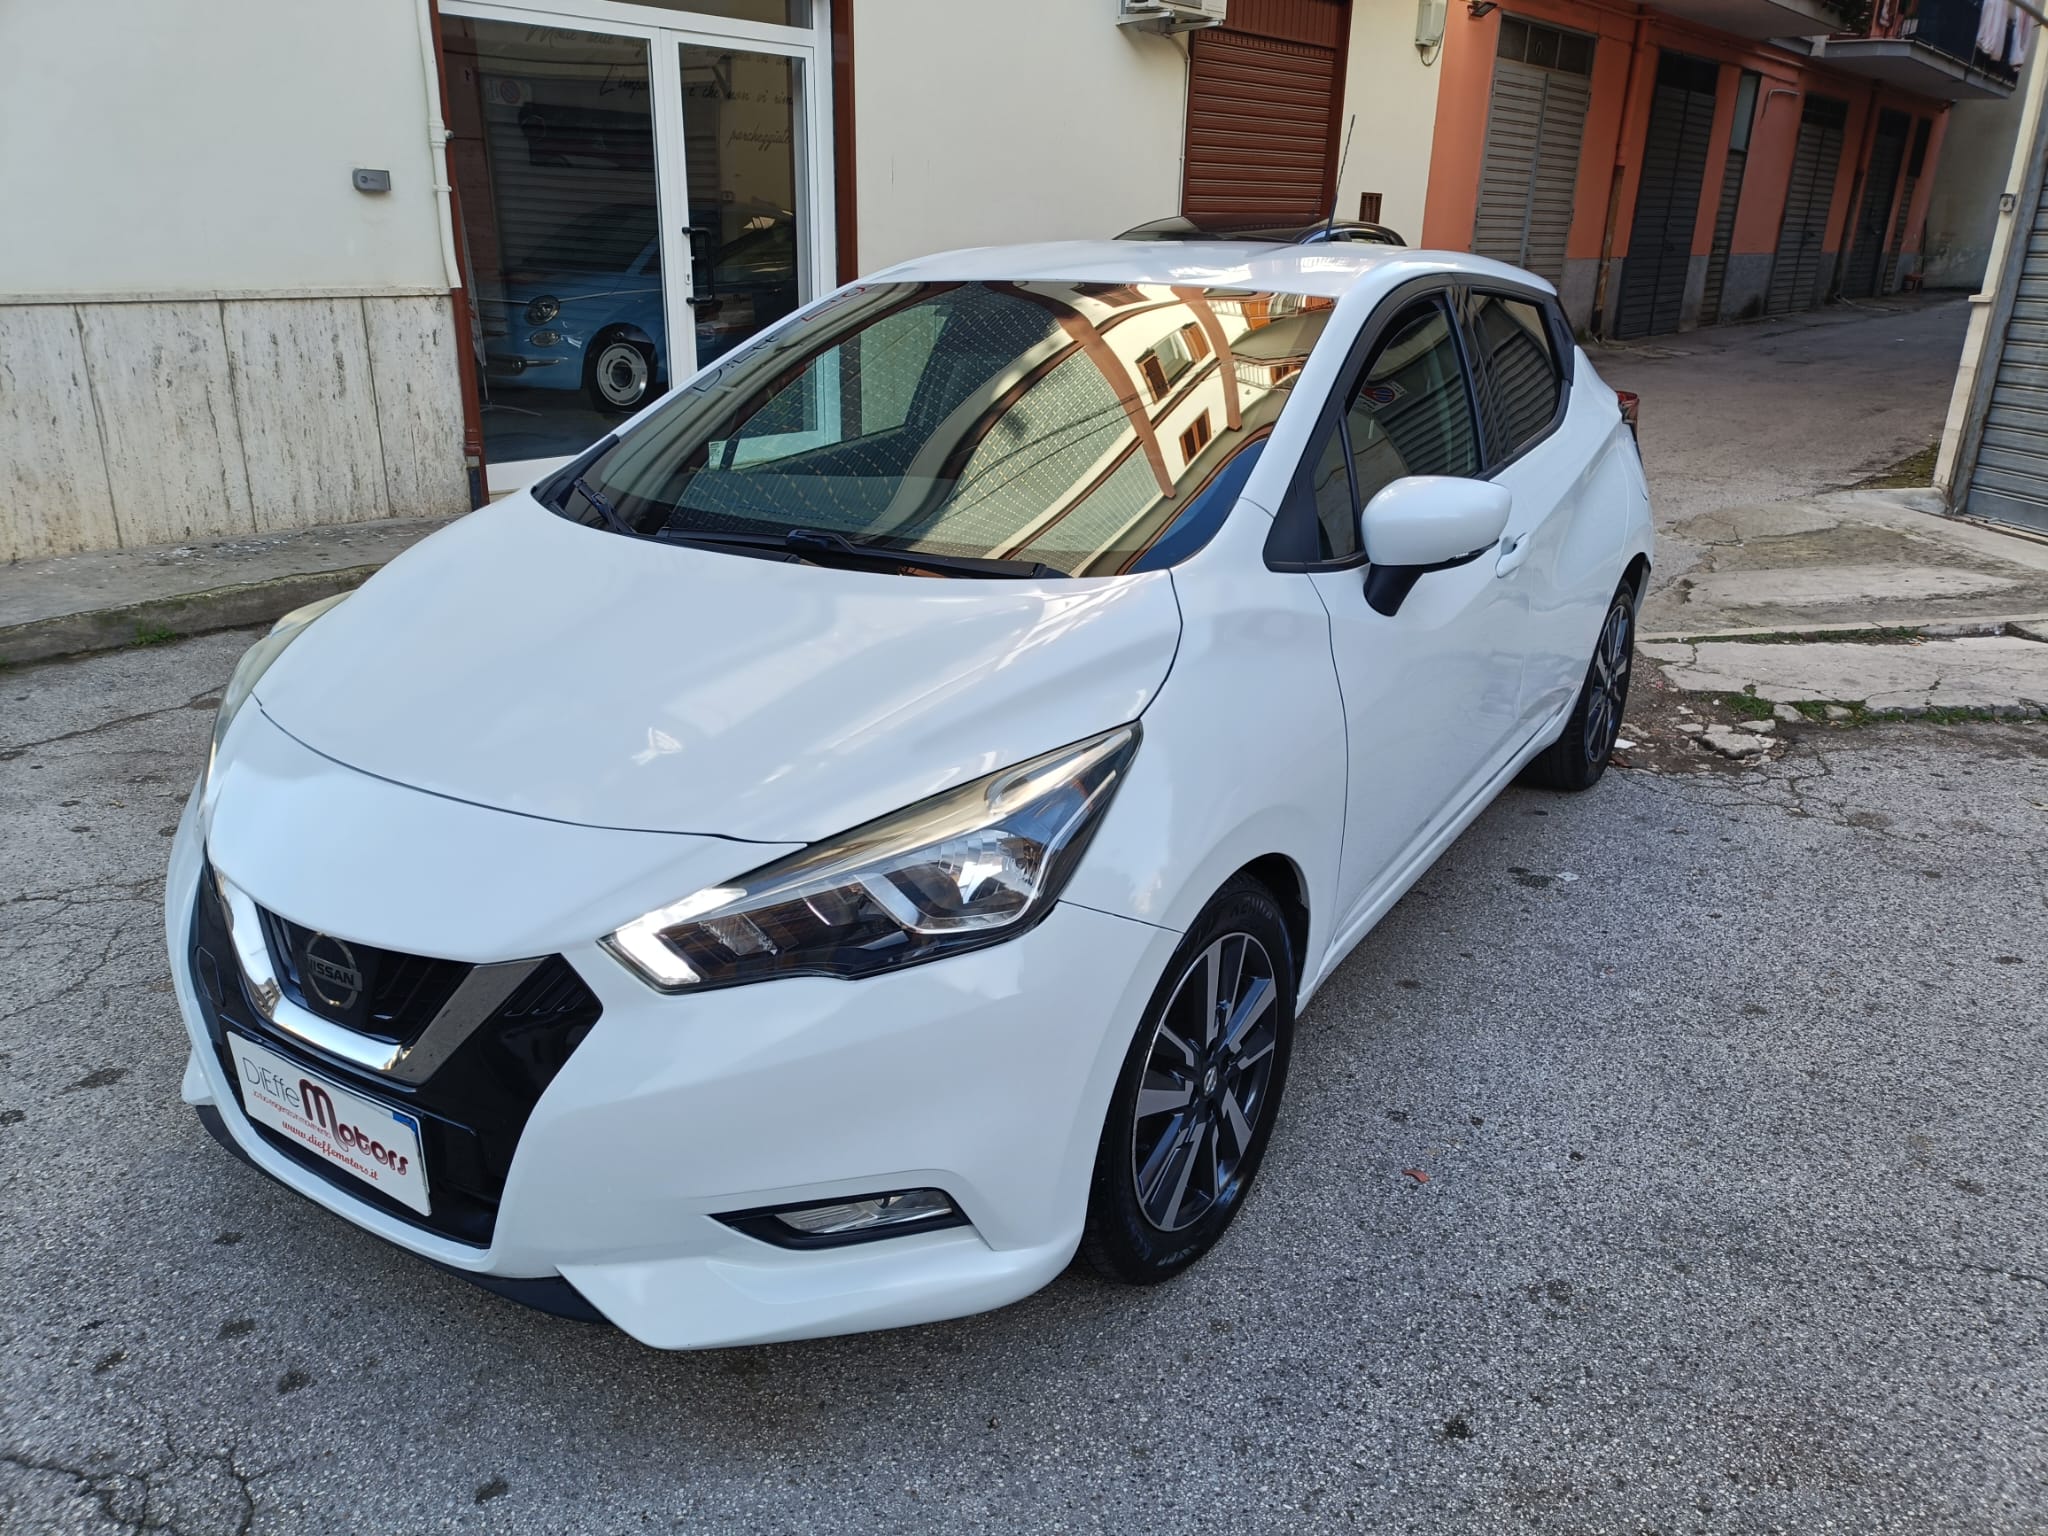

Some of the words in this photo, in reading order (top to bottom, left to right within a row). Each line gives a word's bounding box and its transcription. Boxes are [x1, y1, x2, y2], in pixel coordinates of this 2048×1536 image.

[308, 959, 354, 987] ISSAN
[242, 1057, 300, 1108] DiEffe
[298, 1079, 409, 1176] Motors
[282, 1121, 378, 1180] www.dieffemotors.it
